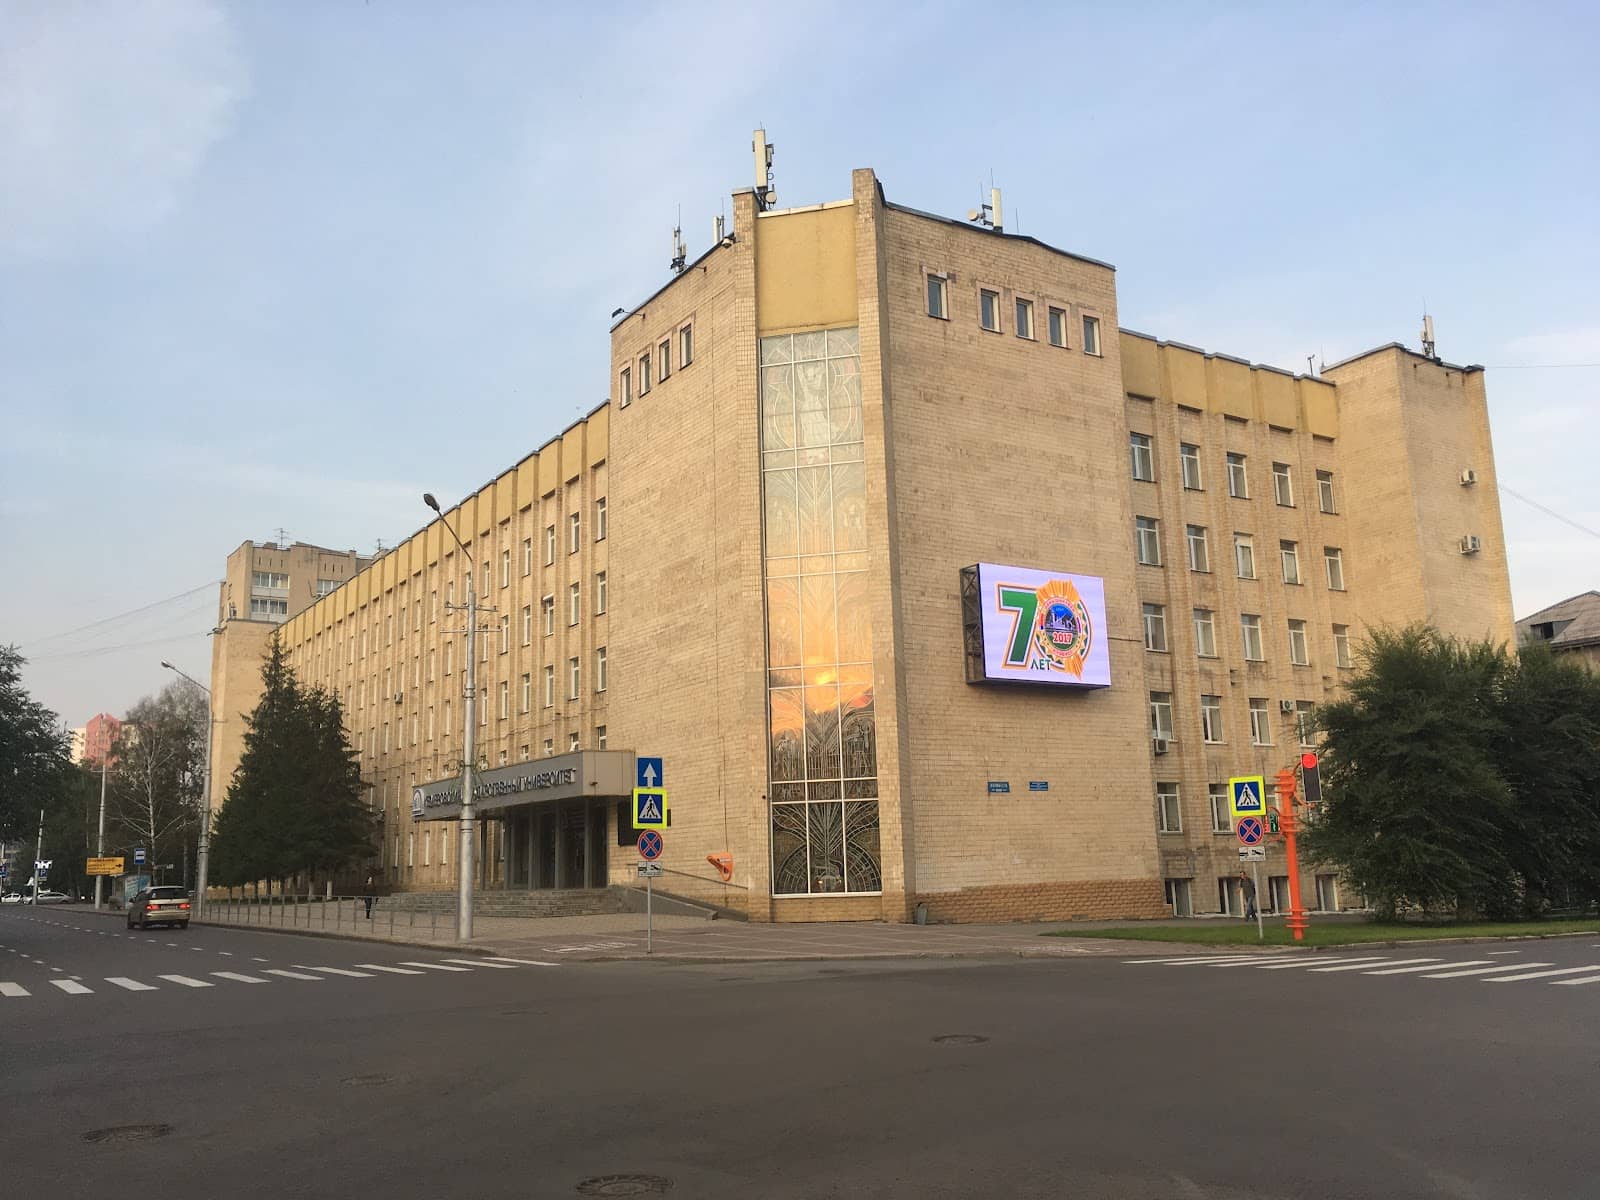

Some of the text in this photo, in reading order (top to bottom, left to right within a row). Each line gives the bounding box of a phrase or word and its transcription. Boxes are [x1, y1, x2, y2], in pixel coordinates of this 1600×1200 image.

[1053, 632, 1072, 644] 2017
[1030, 658, 1051, 671] ЛЕТ
[523, 768, 576, 791] УНИВЕРСИТЕТ
